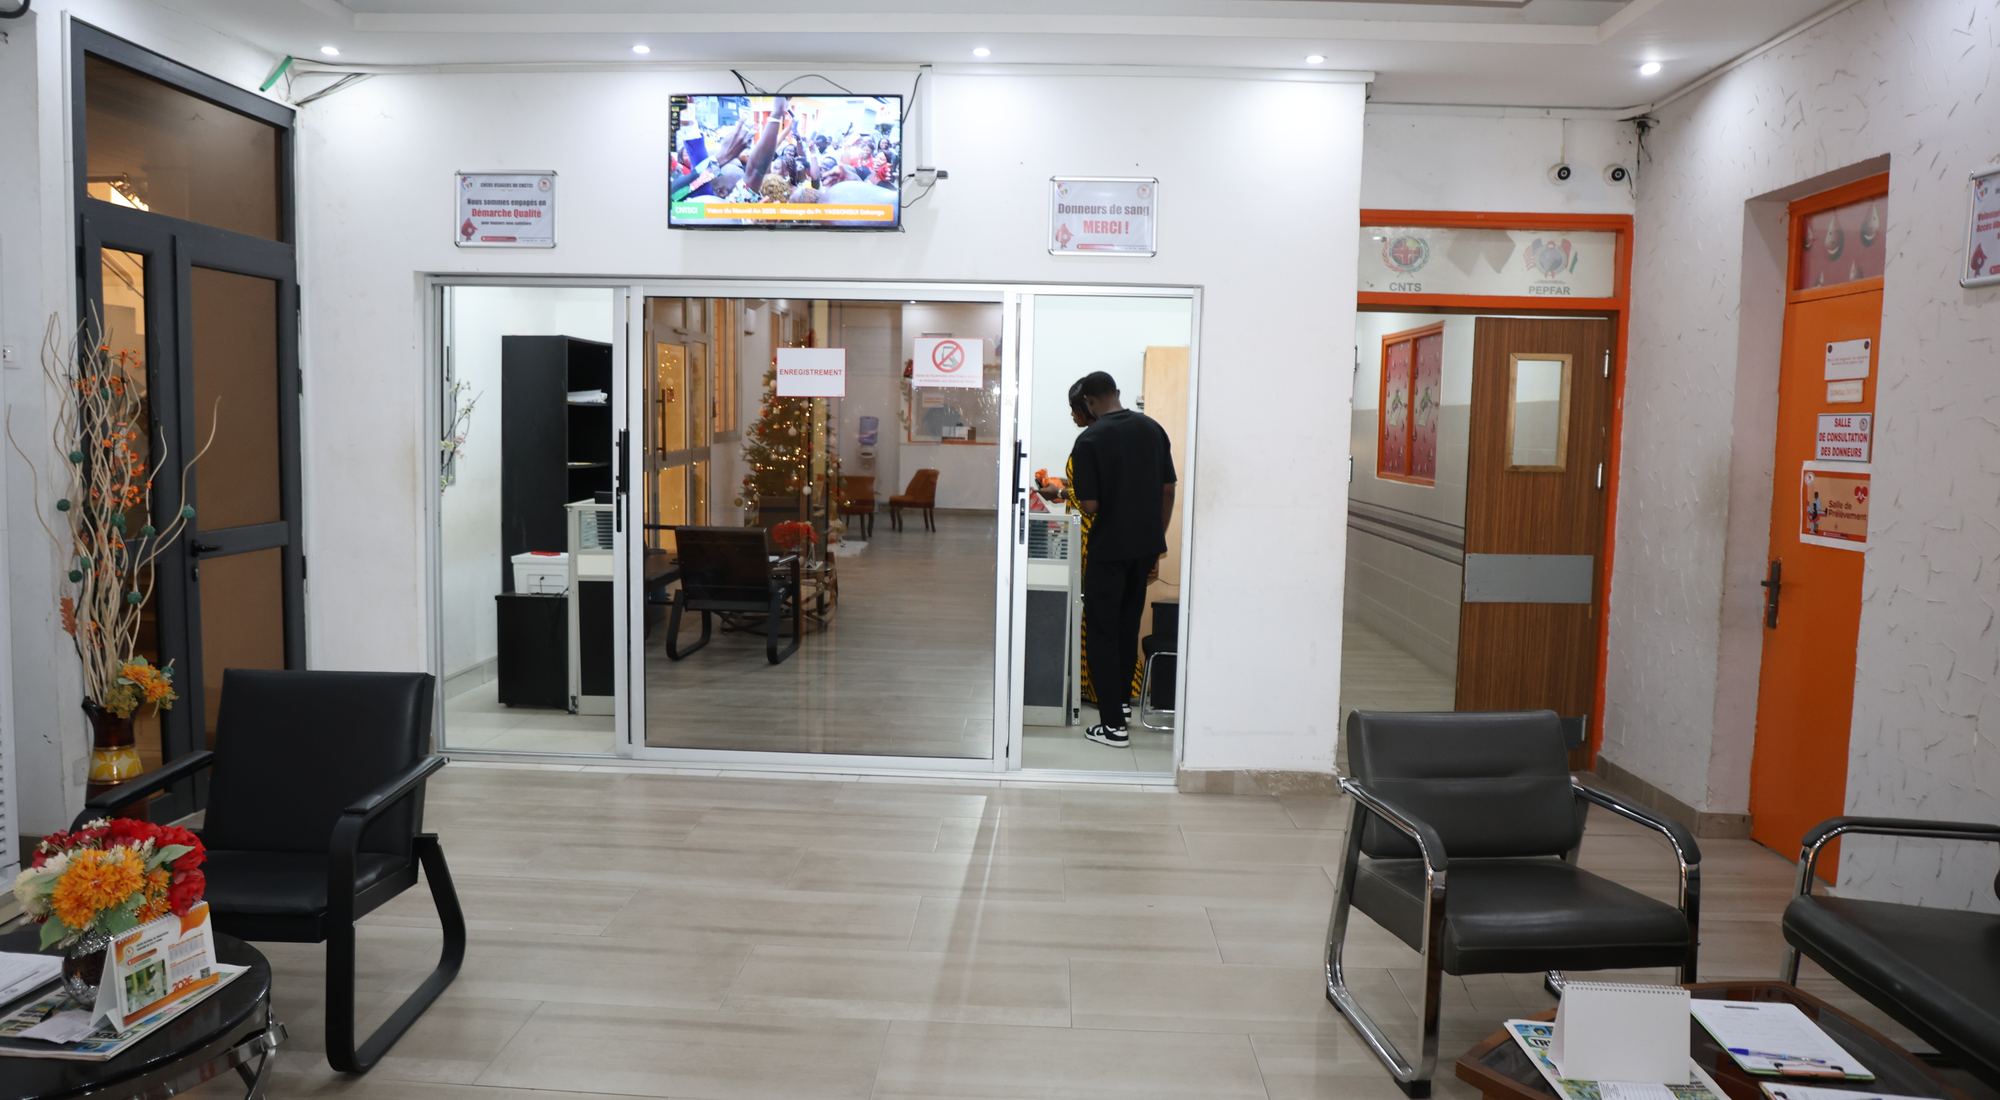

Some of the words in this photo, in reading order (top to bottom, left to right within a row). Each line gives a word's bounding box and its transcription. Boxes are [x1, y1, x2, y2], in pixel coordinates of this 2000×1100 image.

[467, 198, 482, 206] Nous
[1058, 203, 1107, 215] Donneurs
[1109, 204, 1122, 215] de
[1083, 220, 1122, 234] MERCI
[1389, 282, 1422, 292] CNTS
[1528, 286, 1570, 296] PEPFAR
[779, 368, 842, 376] ENREGISTREMENT
[1834, 418, 1851, 428] SALLE
[1819, 432, 1826, 442] DE
[1827, 433, 1868, 443] CONSULTATION
[1821, 446, 1831, 456] DES
[1832, 447, 1862, 458] DONNEURS
[1829, 500, 1843, 509] Salle
[1844, 501, 1852, 510] de
